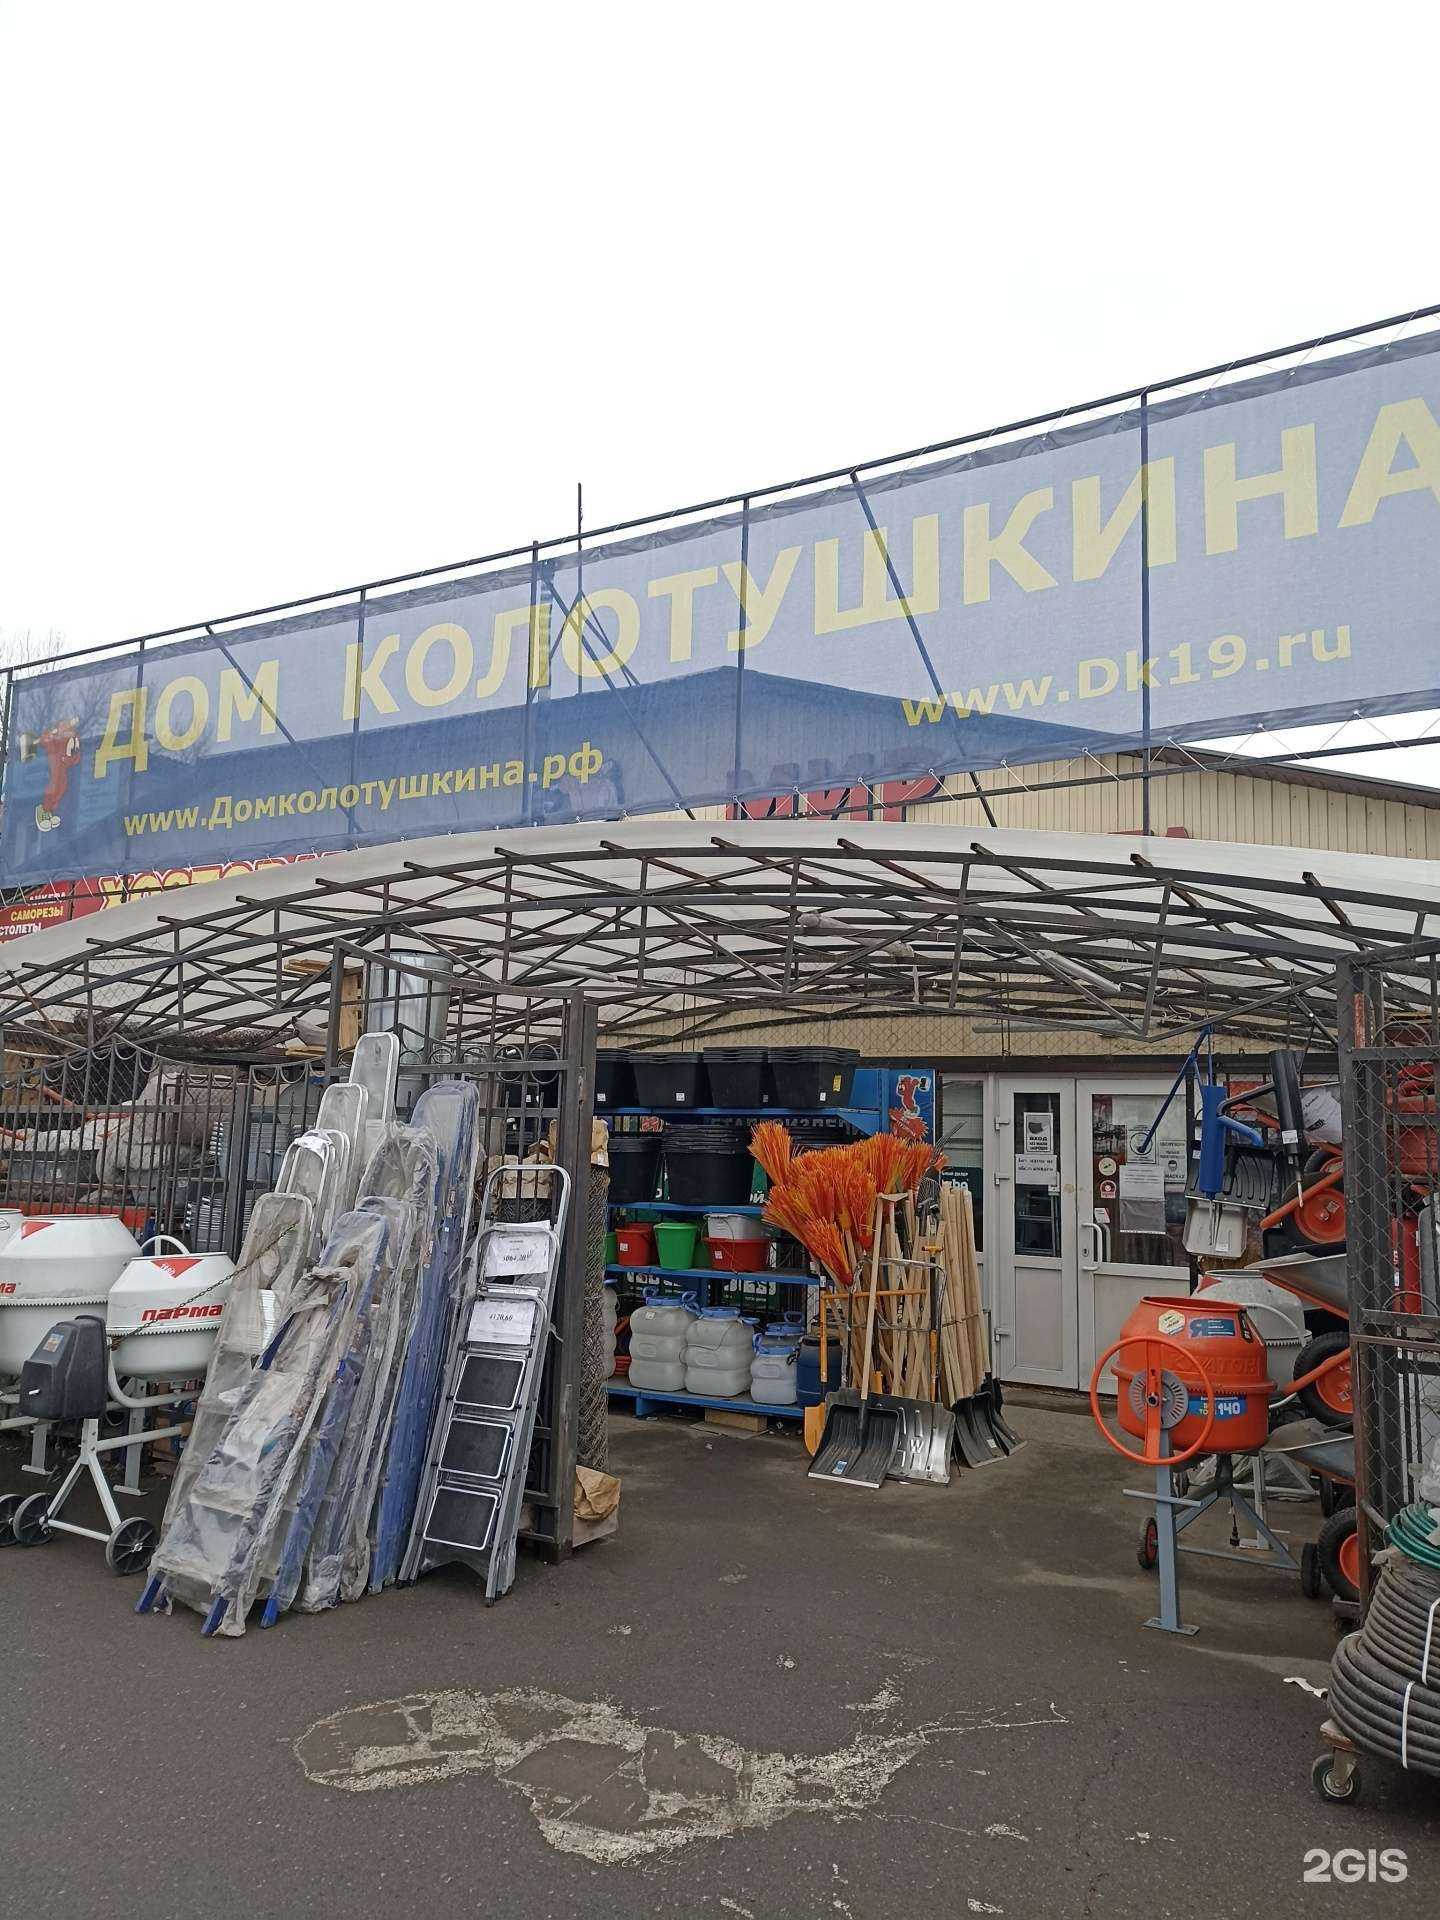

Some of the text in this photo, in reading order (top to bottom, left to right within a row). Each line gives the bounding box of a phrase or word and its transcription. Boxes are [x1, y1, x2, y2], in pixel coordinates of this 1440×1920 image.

[94, 397, 1440, 778] ДОМ КОЛОТУШКИНА
[902, 624, 1352, 726] www.Dk19.ru
[124, 741, 603, 836] www.Домколотушкина.рф
[10, 905, 64, 921] САМОРЕЗЫ
[141, 1304, 223, 1321] парма
[1218, 1402, 1241, 1415] 140
